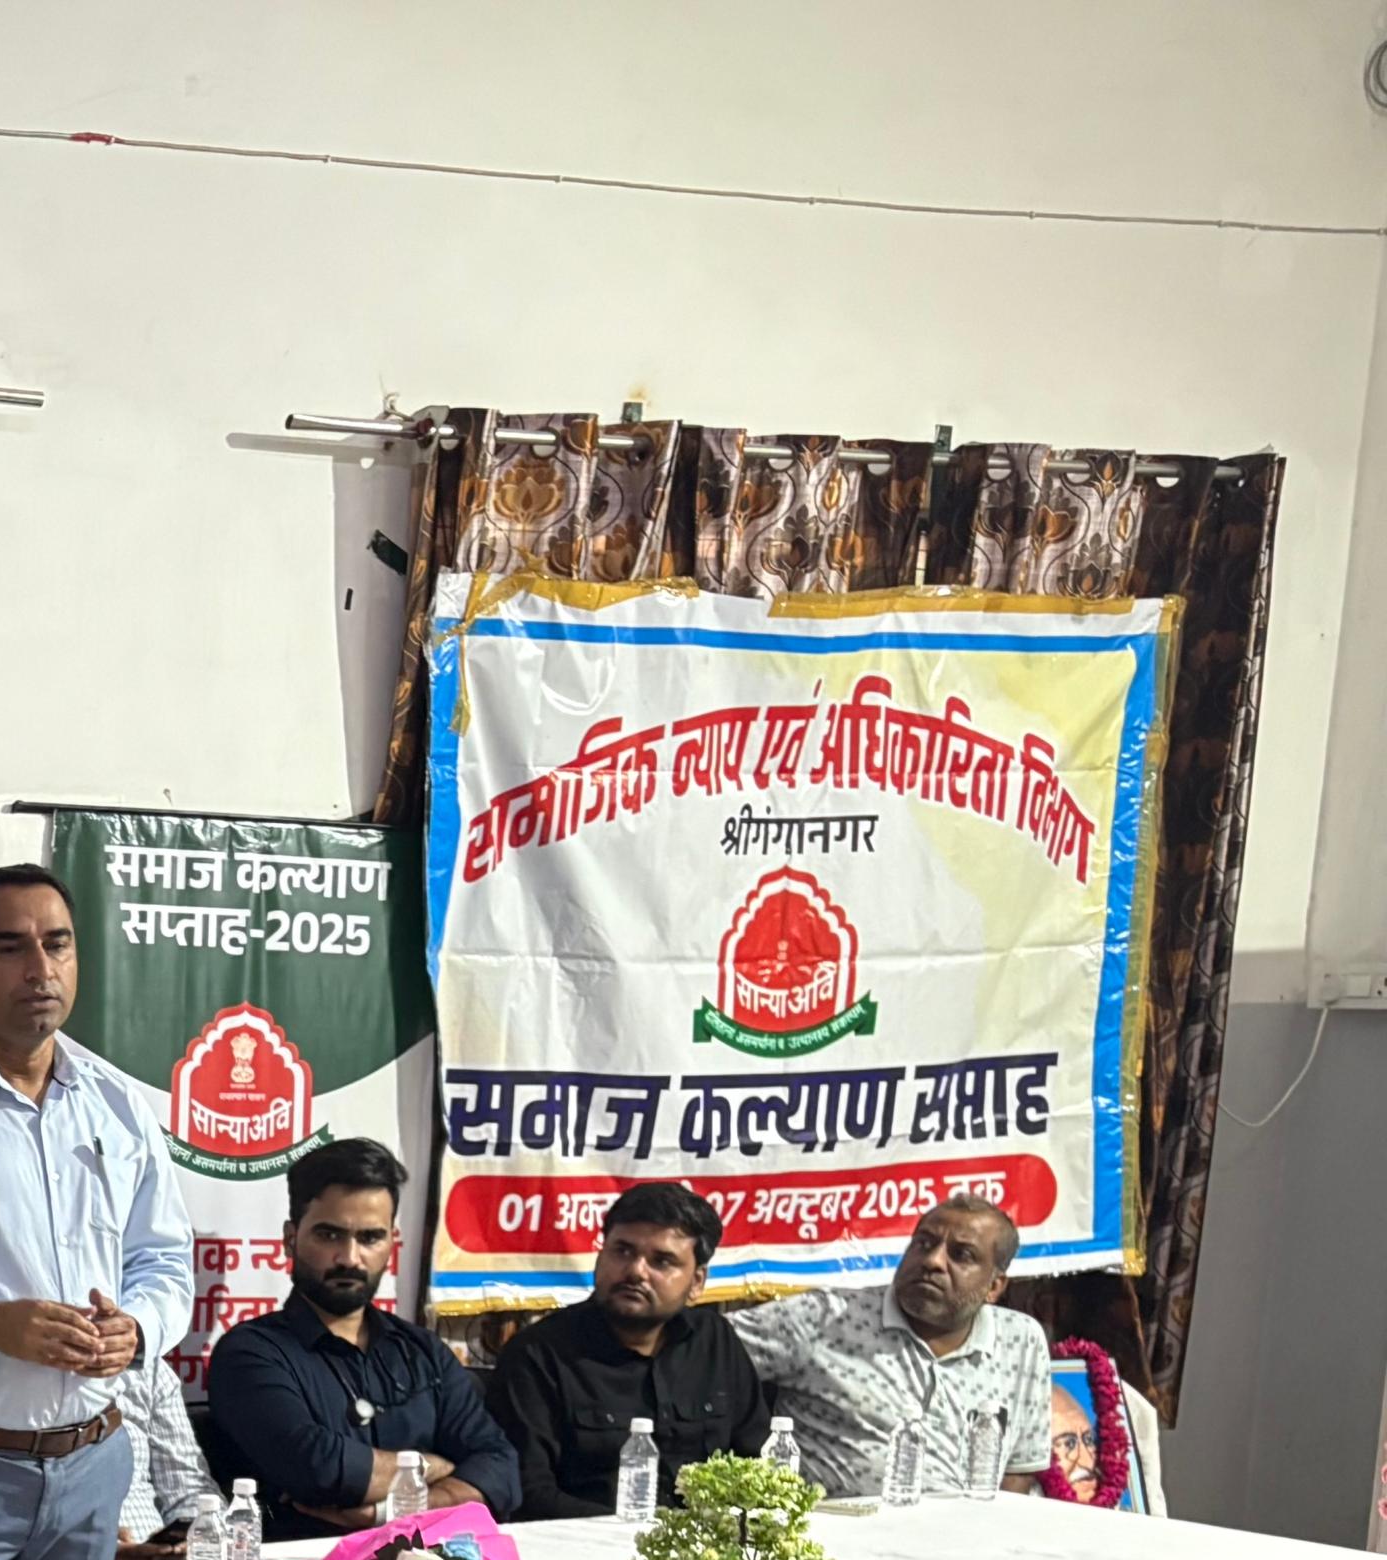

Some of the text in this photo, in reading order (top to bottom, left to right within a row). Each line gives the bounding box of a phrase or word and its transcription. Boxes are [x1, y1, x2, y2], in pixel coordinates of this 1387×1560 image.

[463, 676, 1095, 884] सामाजिक न्याय एवं अधिकारिता विभाग
[720, 804, 879, 855] श्रीगंगानगर
[103, 844, 392, 902] समाज कल्याण
[120, 902, 372, 956] सप्ताह-2025
[446, 1069, 670, 1160] समाज
[679, 1066, 906, 1159] कल्याण
[498, 1193, 543, 1232] 01
[748, 1185, 860, 1240] अक्टूबर
[859, 1179, 938, 1219] 2025
